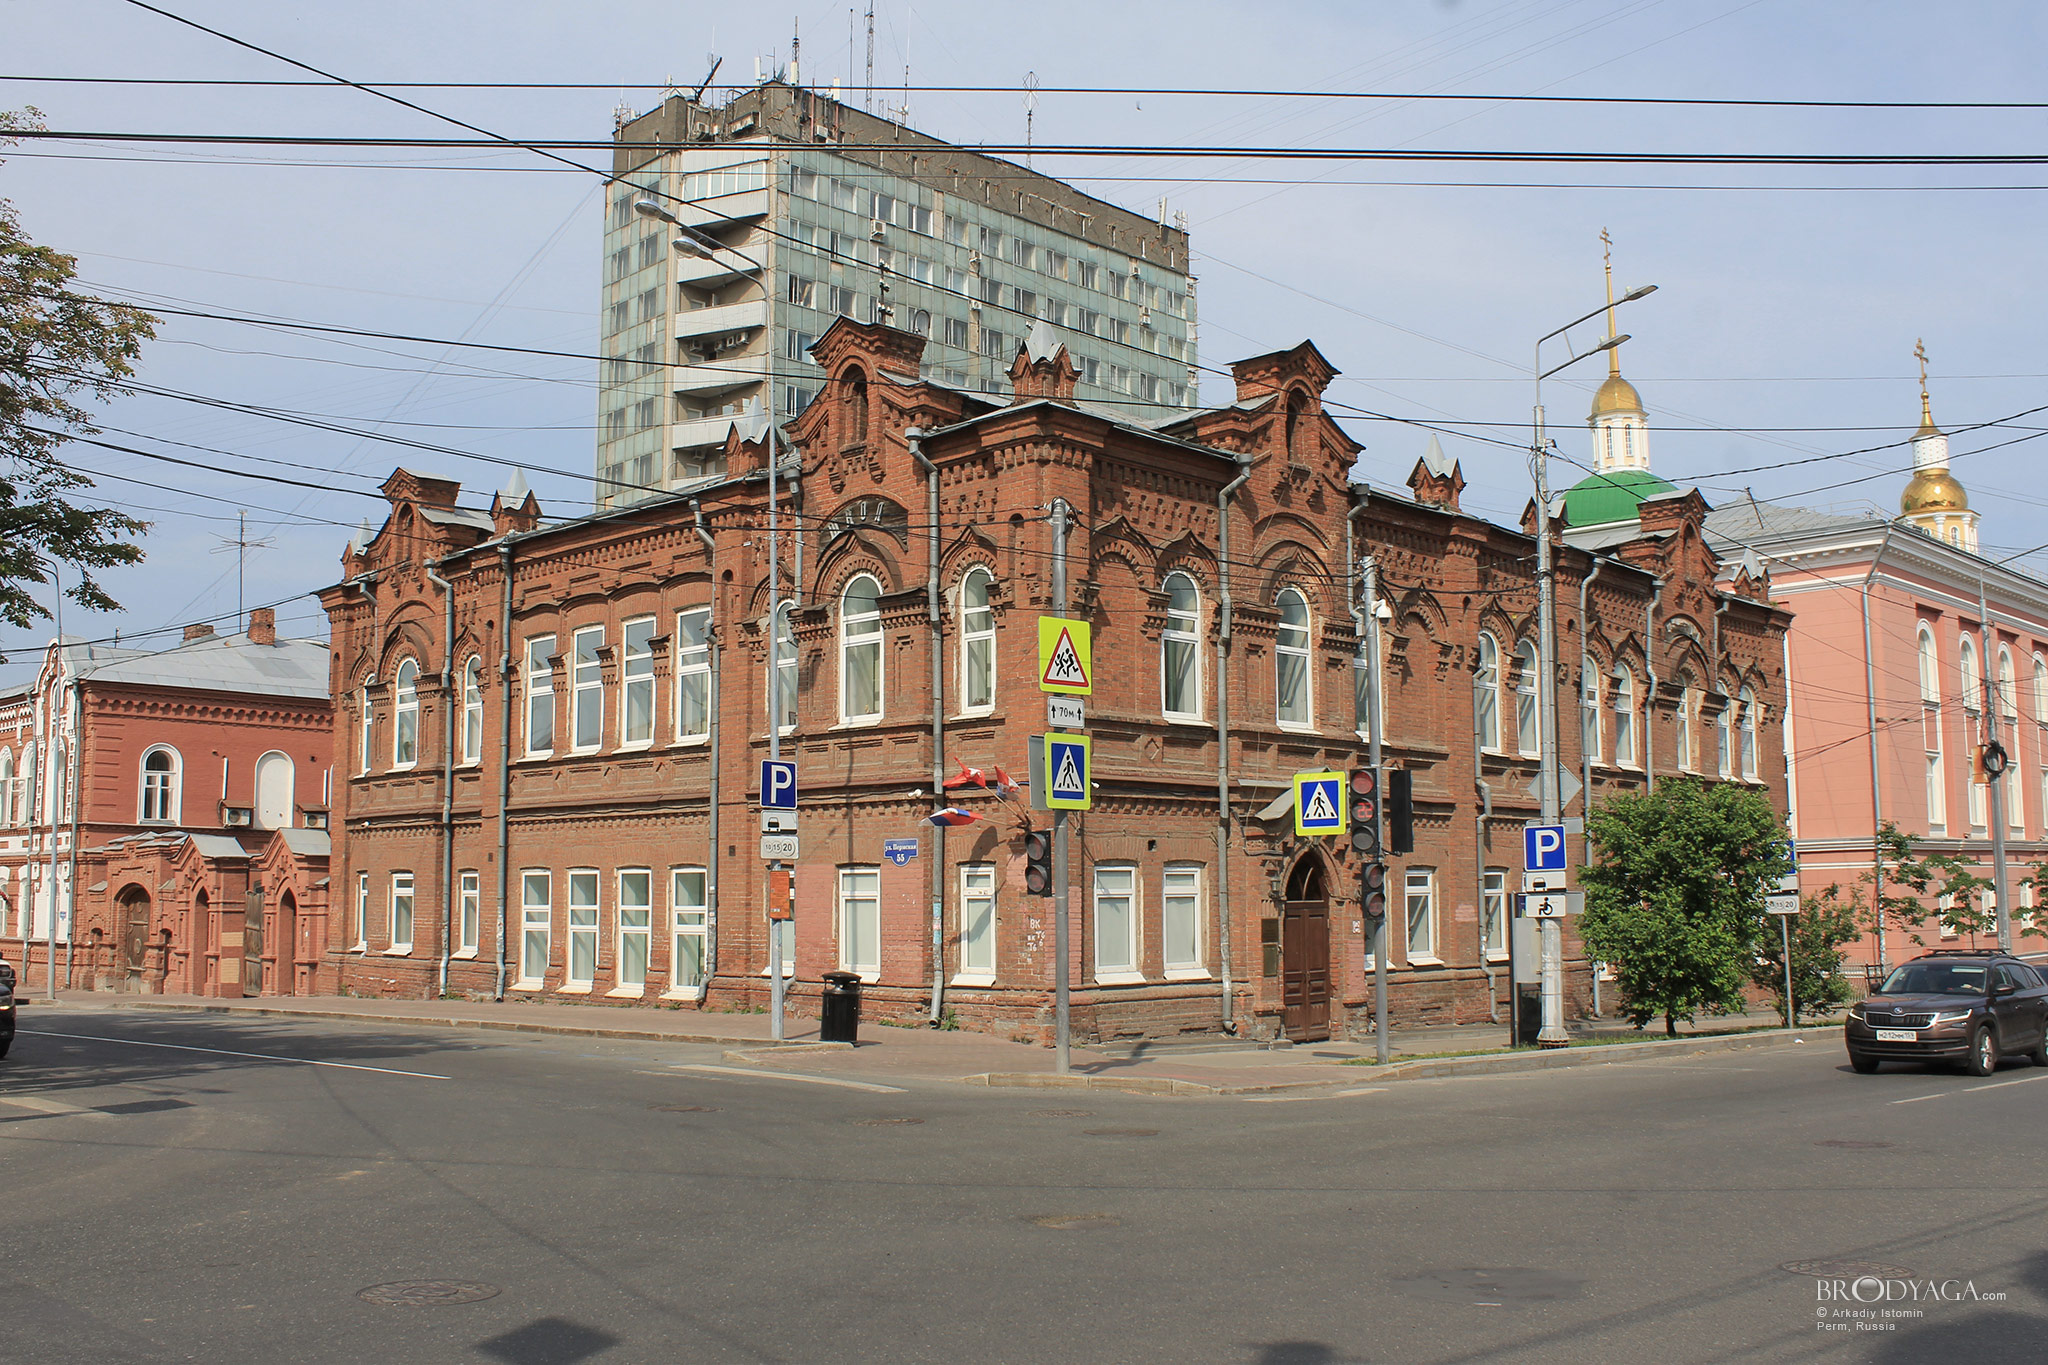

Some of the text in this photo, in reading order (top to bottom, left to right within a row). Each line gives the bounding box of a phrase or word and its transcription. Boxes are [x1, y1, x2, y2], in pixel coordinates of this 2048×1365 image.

[770, 764, 792, 804] P
[783, 843, 792, 852] 20
[896, 853, 905, 862] 55
[1535, 829, 1560, 867] P
